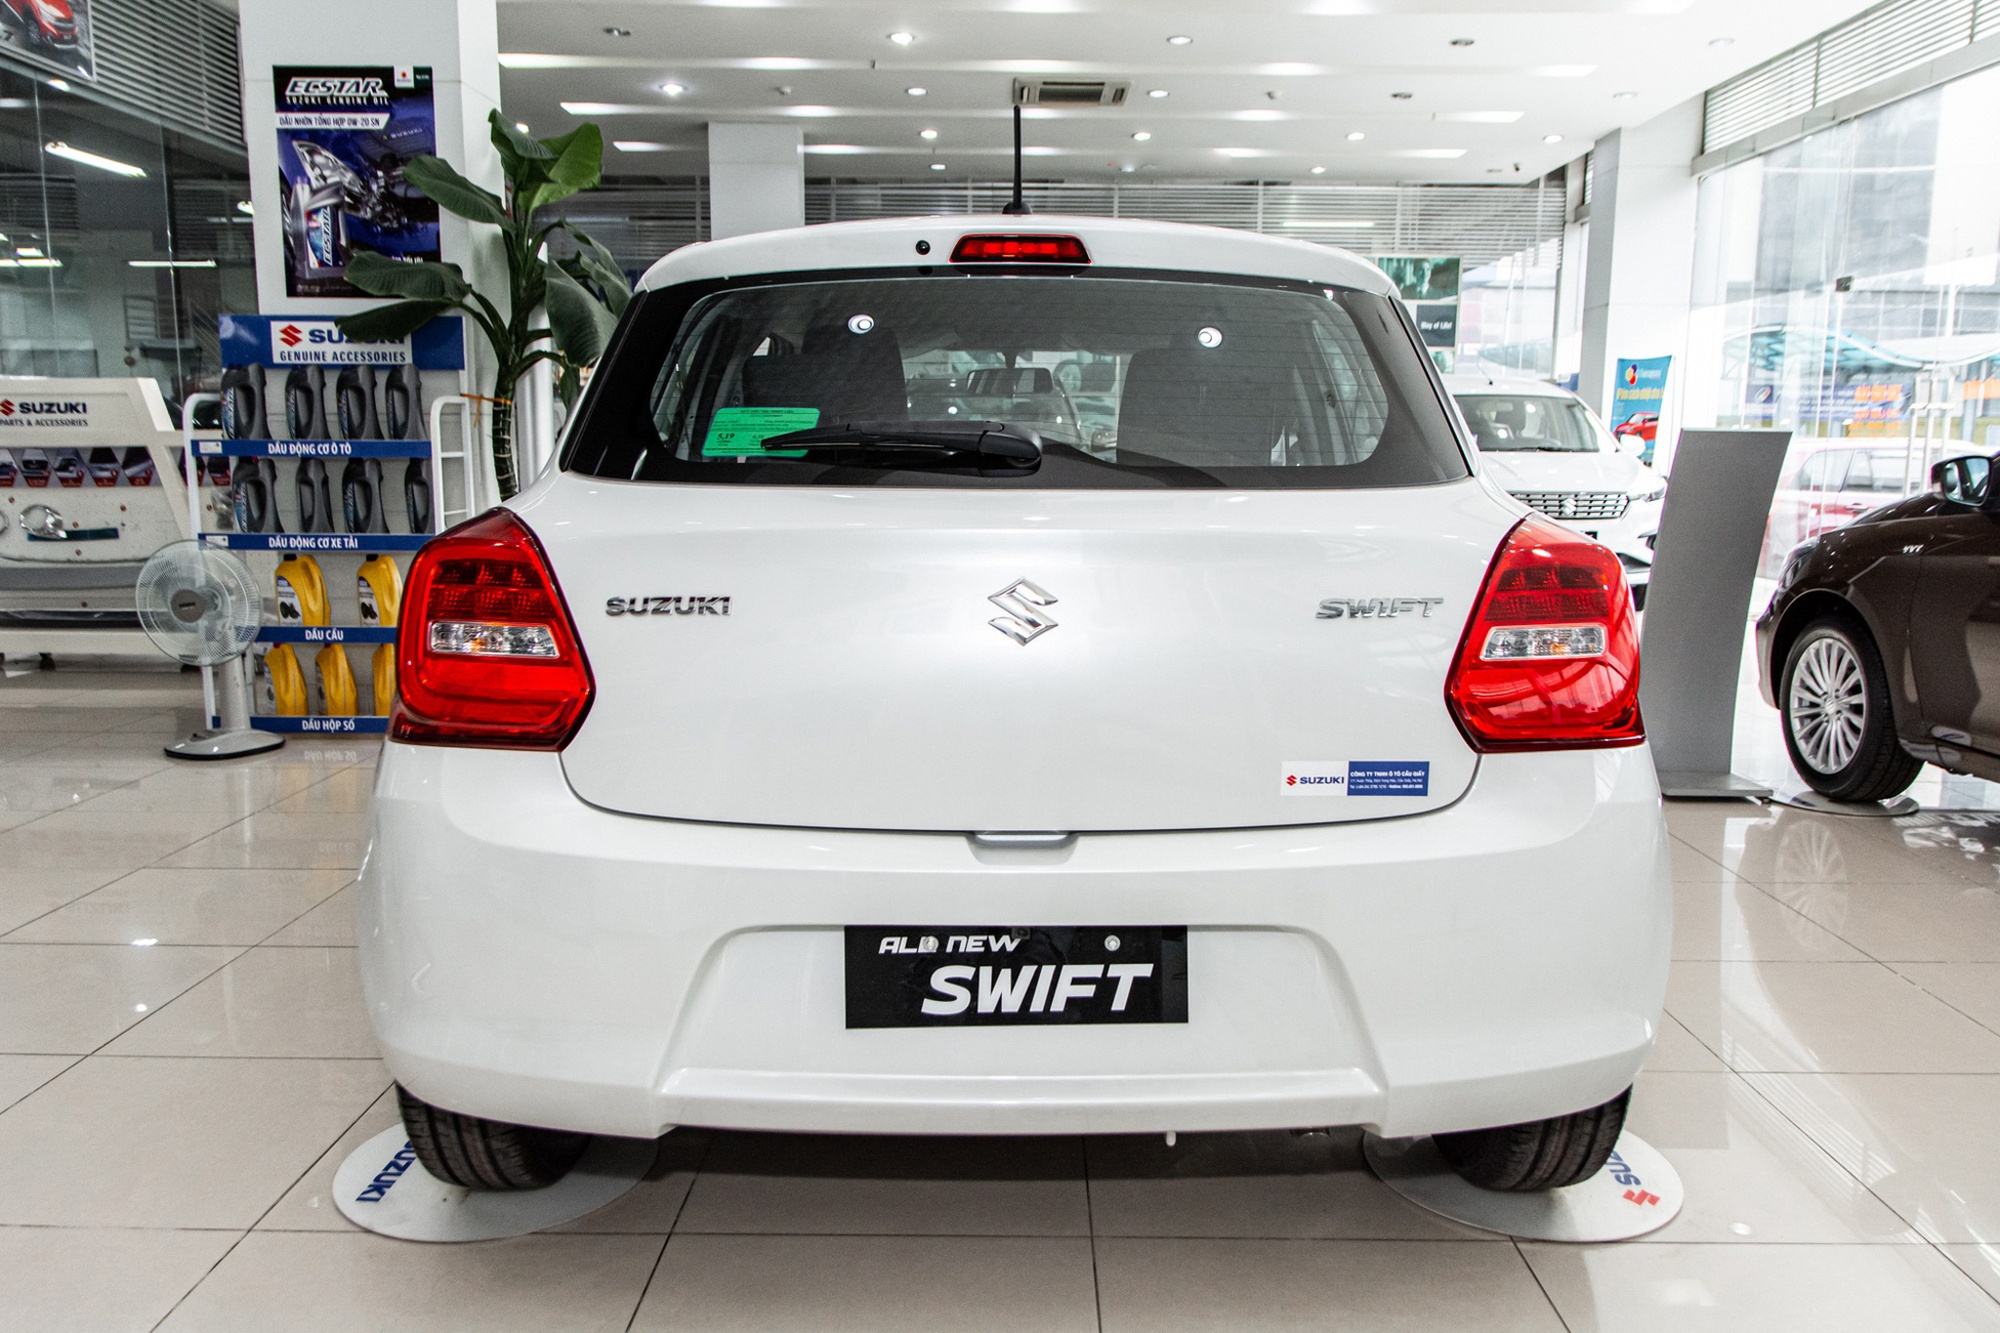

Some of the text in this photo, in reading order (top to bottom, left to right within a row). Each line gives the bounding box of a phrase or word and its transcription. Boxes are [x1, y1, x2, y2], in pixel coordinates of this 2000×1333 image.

[285, 77, 389, 97] ECSTAR
[374, 96, 389, 105] OIL
[371, 118, 380, 126] SN
[280, 351, 406, 362] GENUINE ACCESSORIES
[19, 402, 87, 414] SUZUKI
[26, 419, 33, 427] &
[36, 419, 89, 427] ACCESSORIES
[268, 441, 352, 457] DẦU ĐỘNG CƠ Ô TÔ
[268, 535, 359, 551] DẦU ĐỘNG CƠ XE TẢI
[1902, 544, 1924, 553] VVT
[605, 596, 731, 616] SUZUKI
[1316, 597, 1444, 619] SWIFT
[305, 628, 344, 641] DẦU CẦU
[302, 717, 355, 733] DẦU HỘP SỐ
[1300, 776, 1344, 784] SUZUKI
[946, 934, 1022, 953] NEW
[921, 963, 1154, 1016] SWIFT
